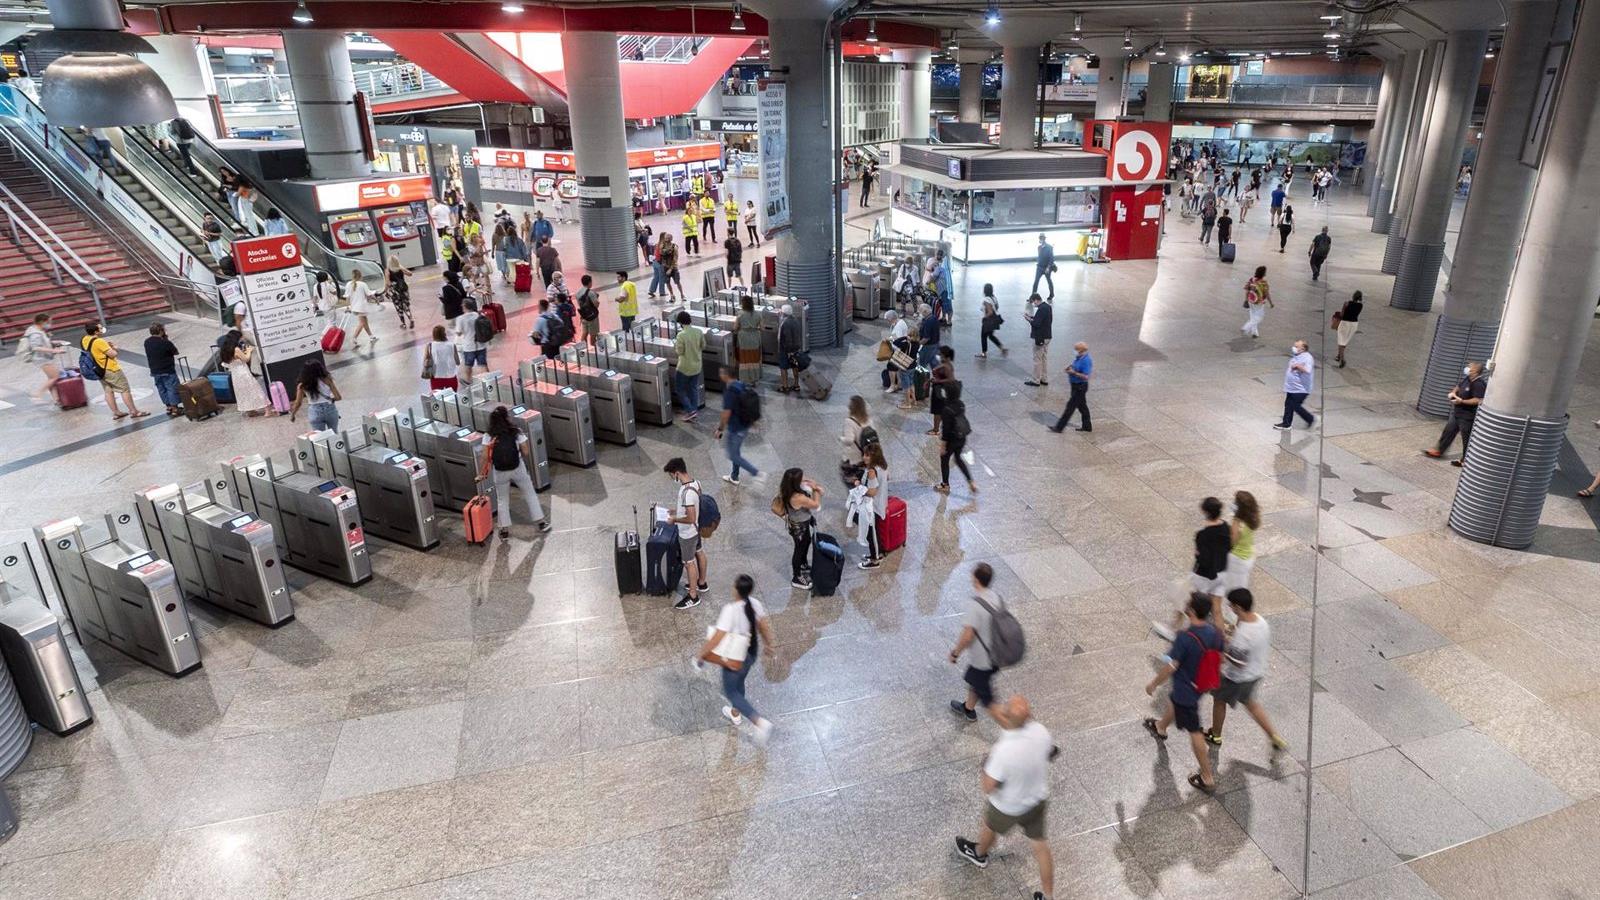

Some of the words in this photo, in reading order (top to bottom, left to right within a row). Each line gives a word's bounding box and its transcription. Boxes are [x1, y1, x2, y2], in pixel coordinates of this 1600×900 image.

[248, 249, 268, 257] Atocha
[256, 276, 274, 284] Oficina
[285, 307, 301, 315] Atocha
[288, 324, 304, 332] Atocha
